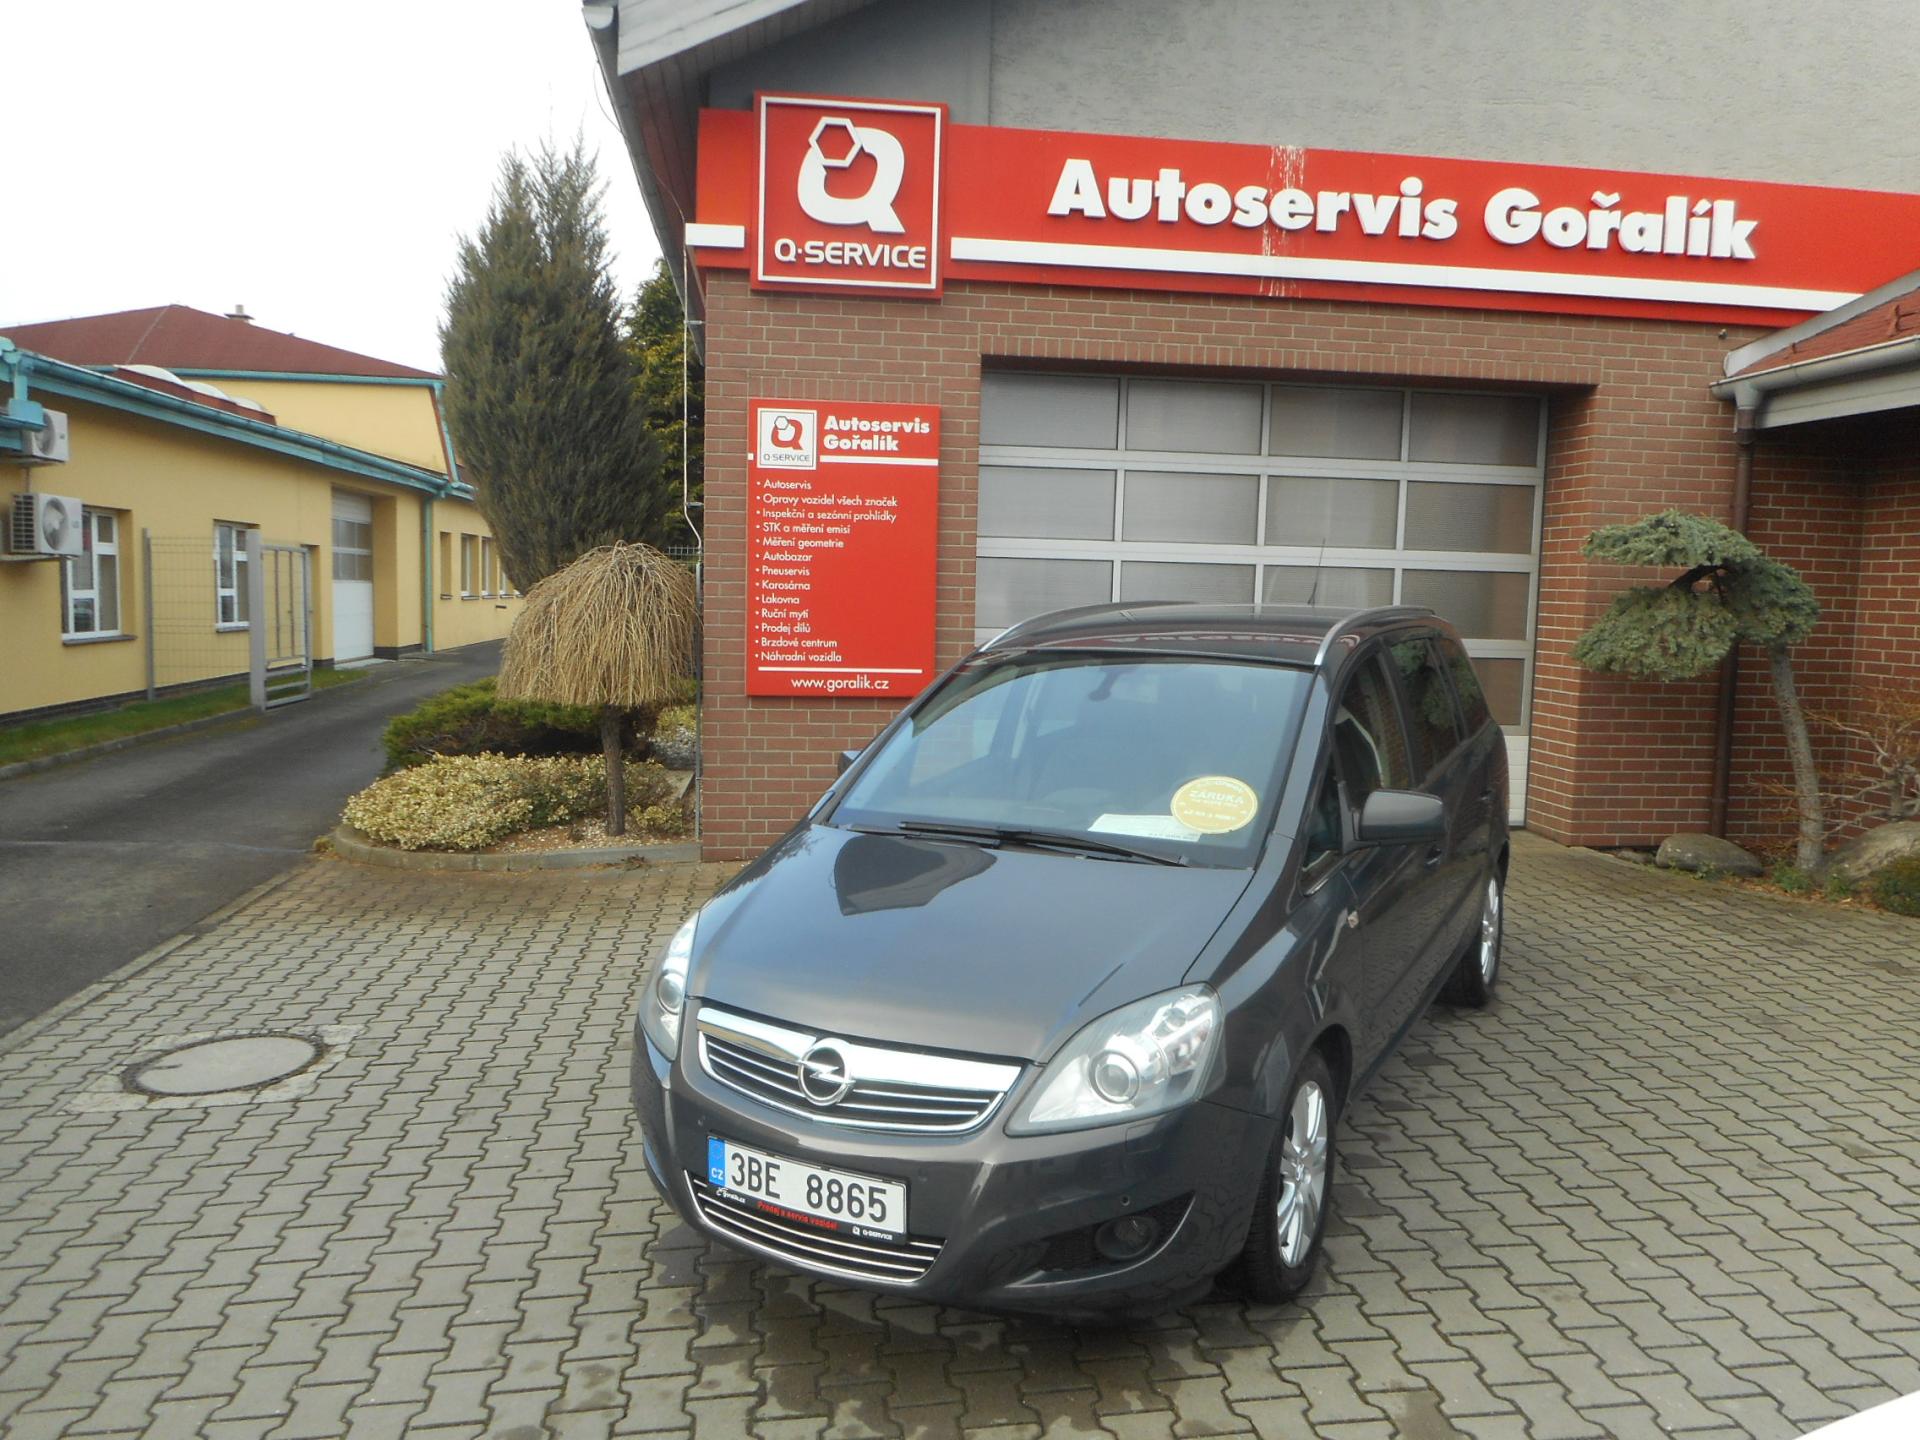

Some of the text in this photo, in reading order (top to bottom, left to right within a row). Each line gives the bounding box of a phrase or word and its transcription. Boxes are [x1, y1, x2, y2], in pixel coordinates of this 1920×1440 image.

[1047, 158, 1758, 260] Autoservis Gořalík
[824, 415, 931, 434] Autoservis
[823, 434, 900, 452] Gořalík
[763, 479, 812, 491] Autoservis
[763, 494, 898, 507] Opravy vozidel všech značek
[763, 508, 897, 524] Inspekční a sezónní prohlídky
[763, 522, 781, 533] STK
[783, 525, 790, 533] a
[792, 522, 824, 534] měření
[762, 536, 844, 550] Měření geometrie
[762, 551, 813, 562] Autobazar
[762, 565, 810, 577] Pneuservis
[761, 579, 811, 591] Karosárna
[761, 593, 800, 605] Lakovna
[761, 607, 787, 619] Ruční
[761, 621, 811, 635] Prodej dílů
[761, 636, 838, 649] Brzdové centrum
[761, 650, 842, 663] Náhradní vozidla
[791, 674, 890, 692] www.goralik.cz
[711, 1167, 725, 1181] CZ
[731, 1152, 888, 1223] 3BE 8865
